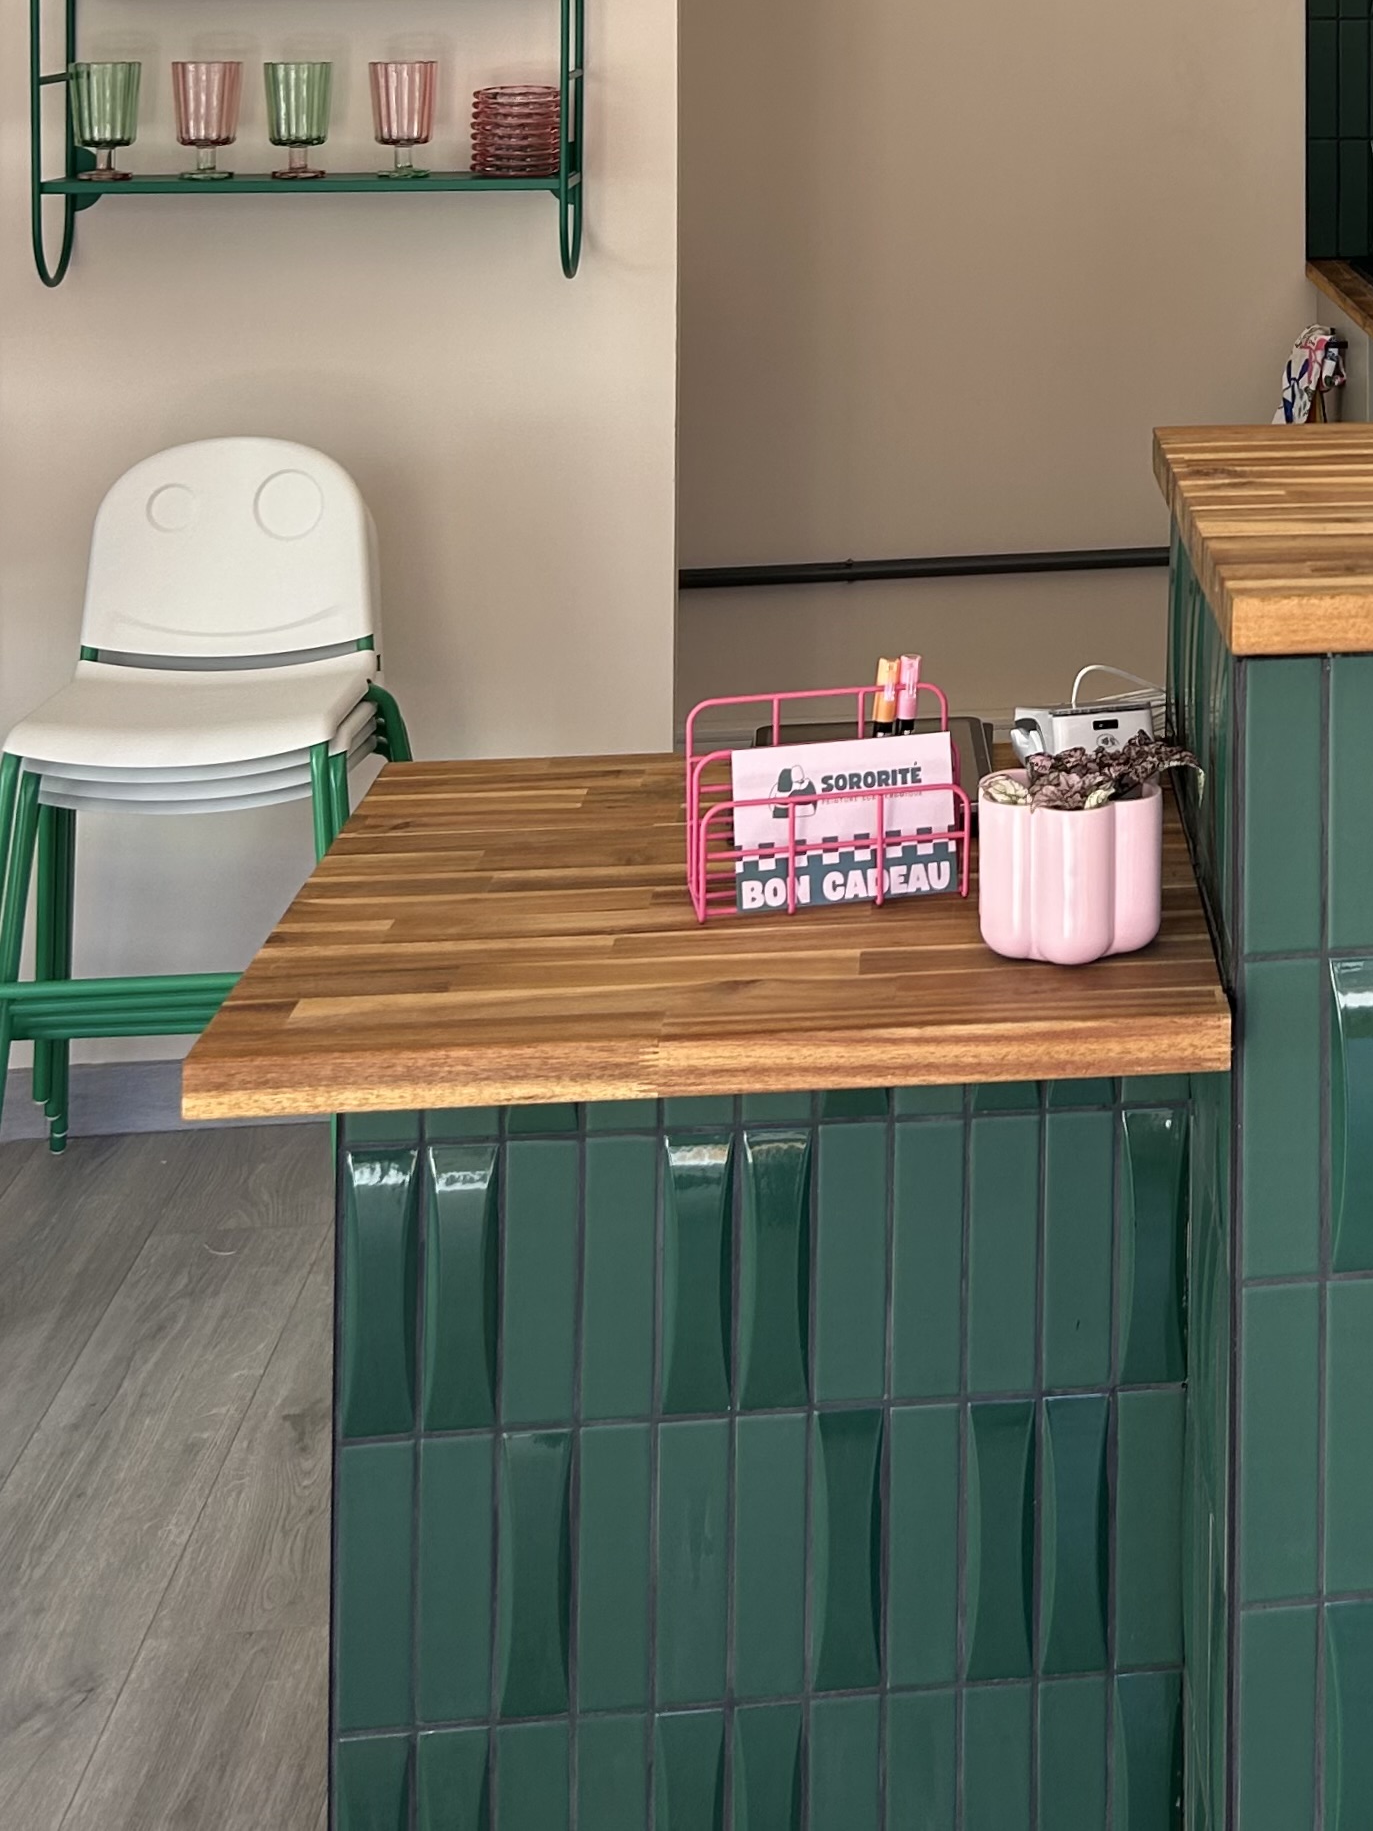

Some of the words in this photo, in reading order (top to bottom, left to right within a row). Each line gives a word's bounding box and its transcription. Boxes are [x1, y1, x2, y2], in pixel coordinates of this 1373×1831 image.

[820, 761, 922, 793] SORORITÉ
[742, 874, 811, 909] BON
[822, 860, 951, 902] CADEAU
